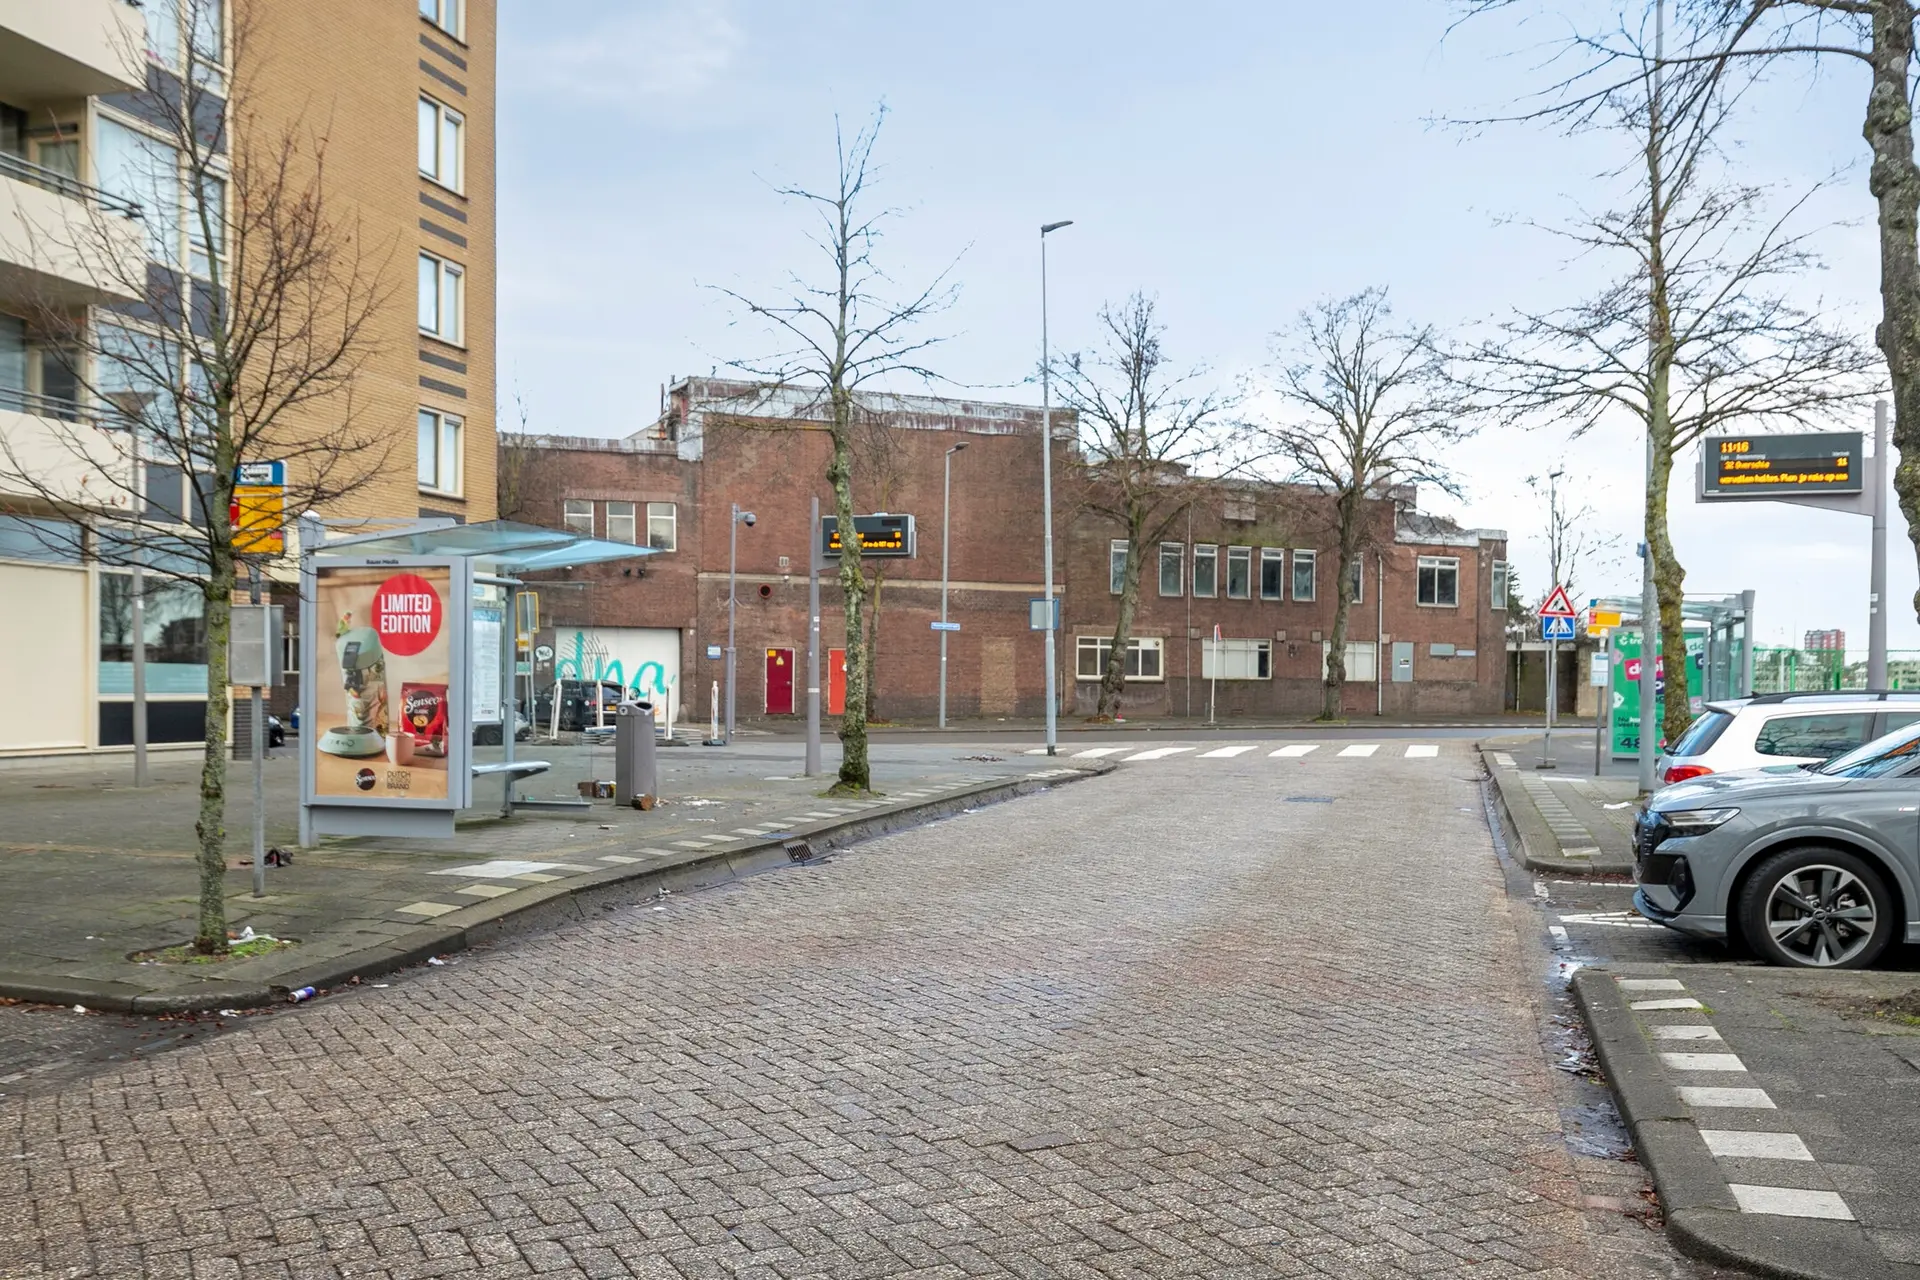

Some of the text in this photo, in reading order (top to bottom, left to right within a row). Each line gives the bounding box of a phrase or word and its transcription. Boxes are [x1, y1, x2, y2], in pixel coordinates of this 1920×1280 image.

[1721, 441, 1749, 453] 11:16
[381, 594, 432, 613] LIMITED
[381, 614, 431, 634] EDITION
